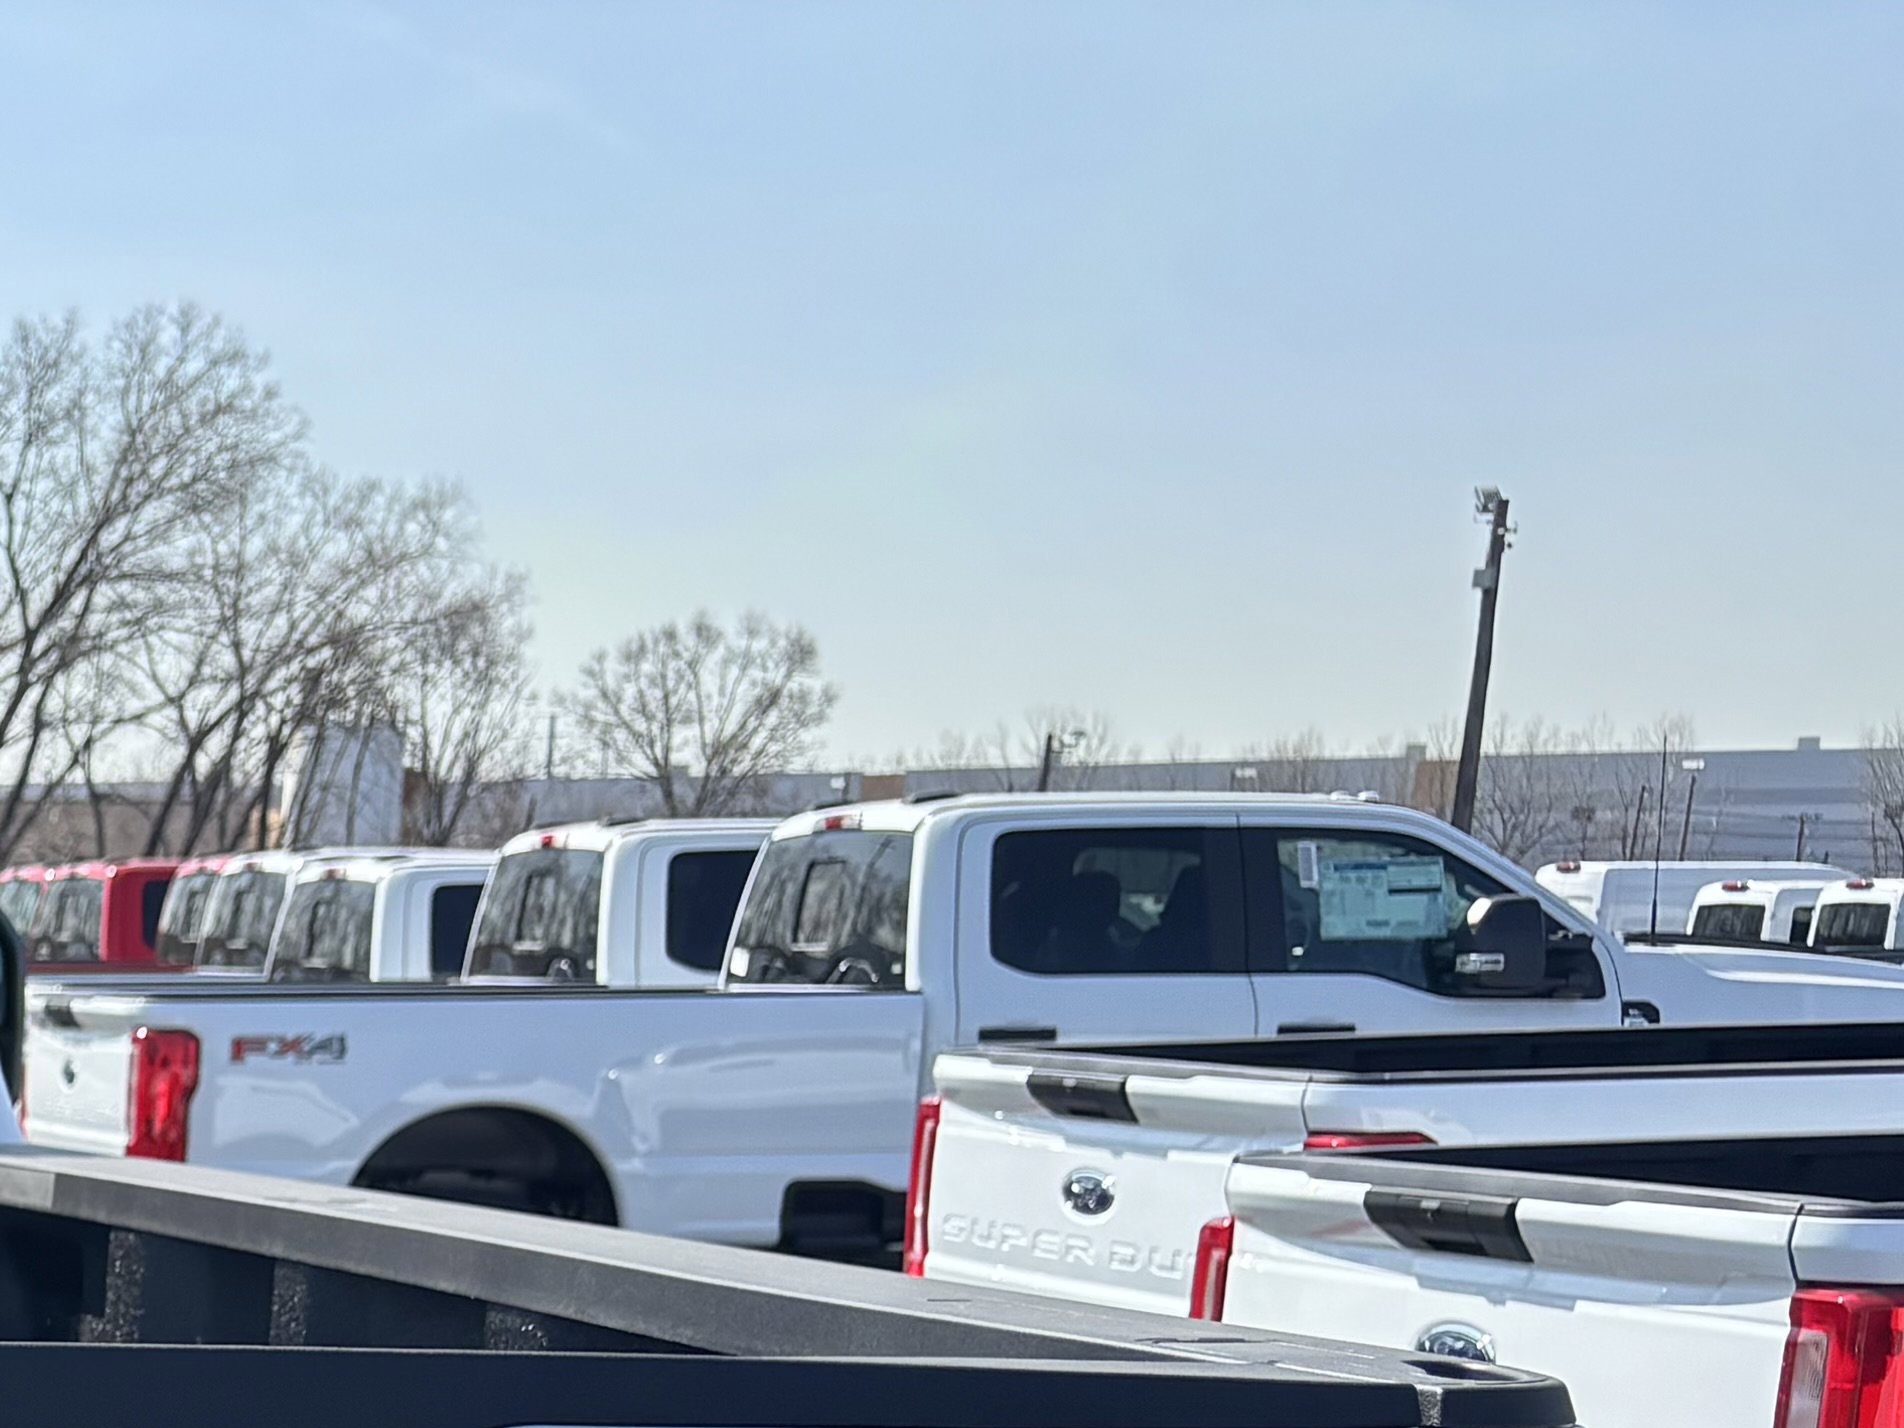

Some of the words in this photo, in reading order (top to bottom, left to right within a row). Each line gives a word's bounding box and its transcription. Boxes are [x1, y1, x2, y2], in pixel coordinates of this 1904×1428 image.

[230, 1034, 347, 1064] FX4
[942, 1212, 1096, 1266] SUPER
[1108, 1240, 1193, 1280] DU
